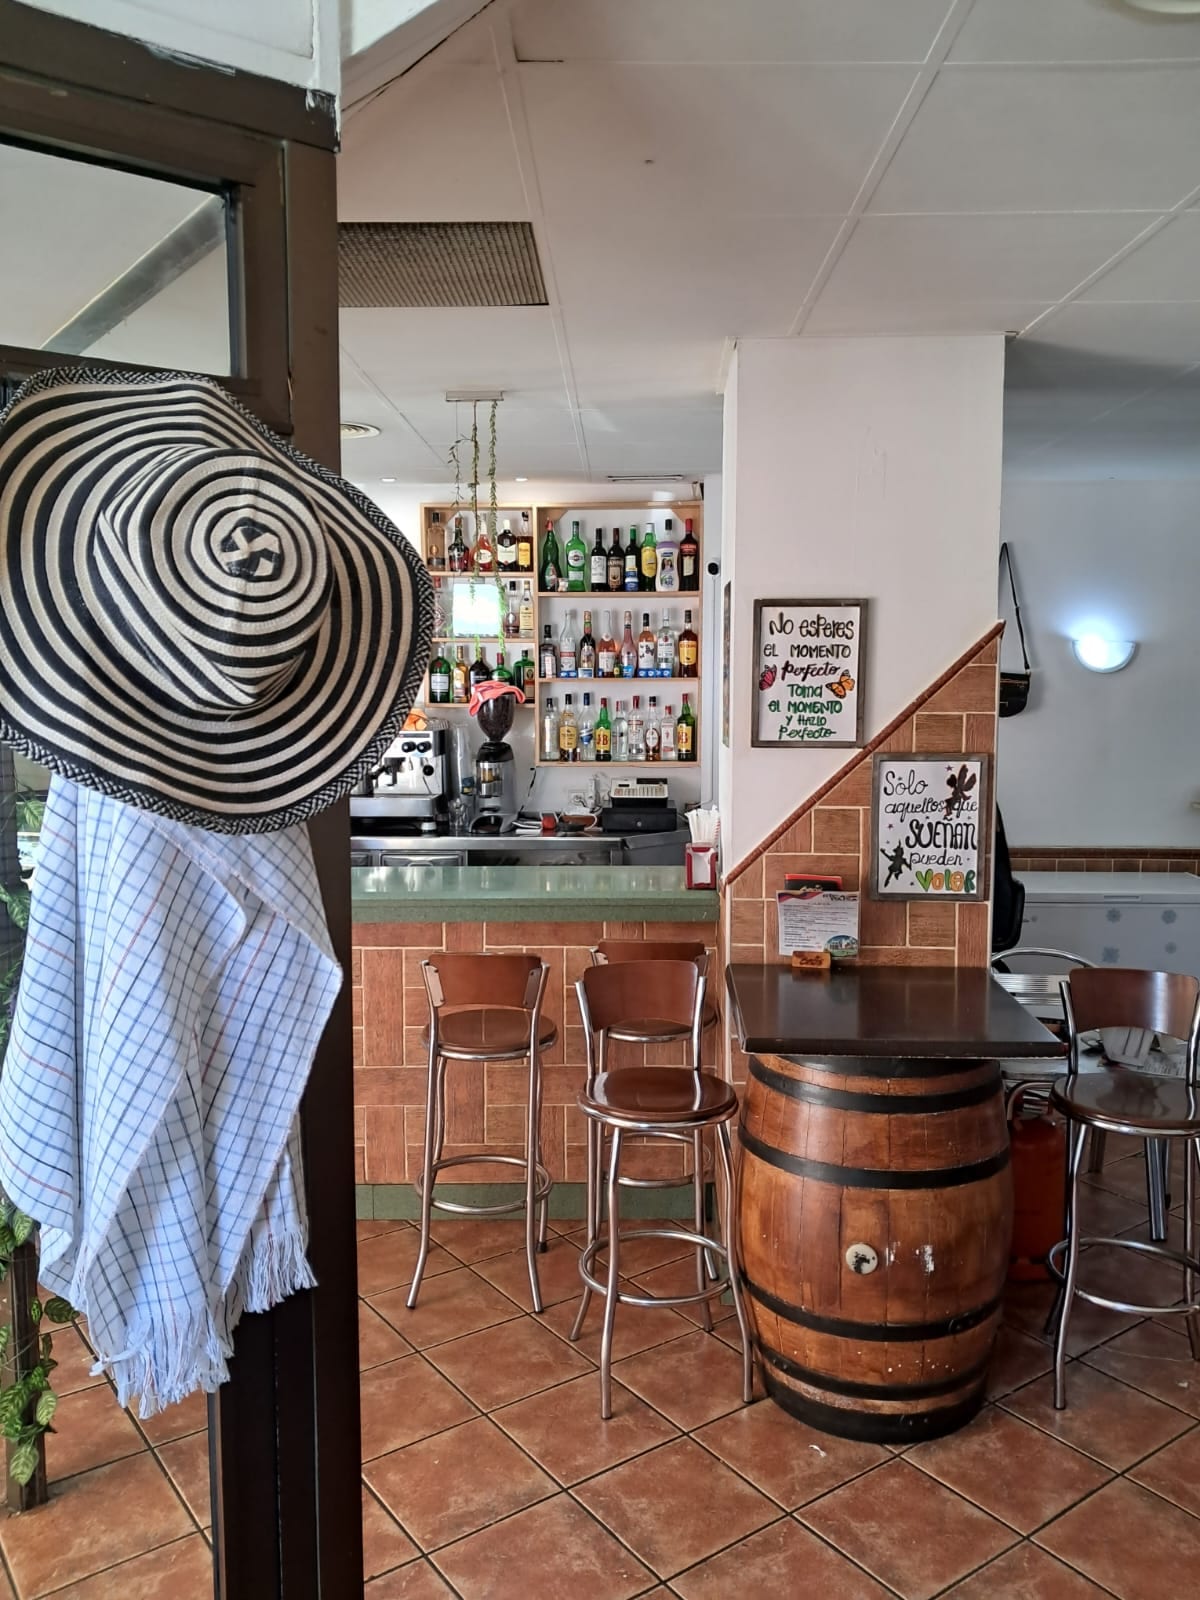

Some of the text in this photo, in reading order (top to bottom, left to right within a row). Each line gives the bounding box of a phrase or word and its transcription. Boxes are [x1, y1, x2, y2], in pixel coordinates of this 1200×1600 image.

[769, 612, 794, 635] No
[791, 644, 851, 659] MOMENTO
[787, 684, 823, 698] Toma
[788, 701, 843, 714] MOMENTO
[596, 734, 609, 746] JB
[676, 731, 688, 744] JB
[885, 798, 977, 823] aquellos que
[905, 816, 977, 850] SUEÑAN
[909, 849, 963, 866] pueden
